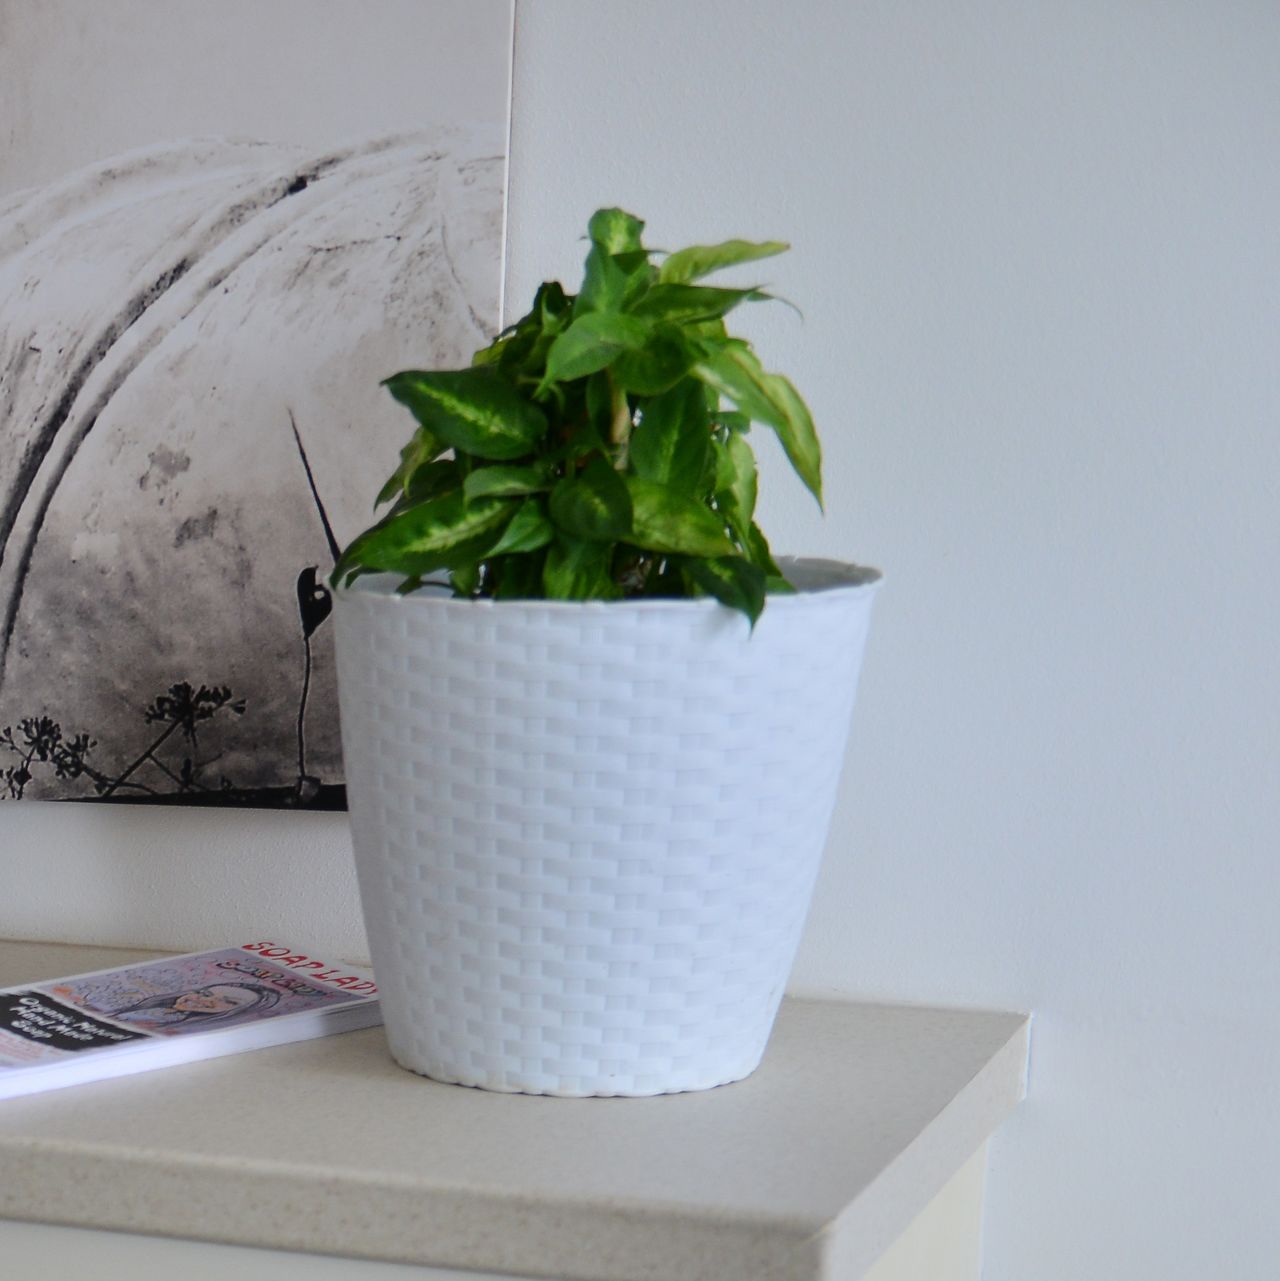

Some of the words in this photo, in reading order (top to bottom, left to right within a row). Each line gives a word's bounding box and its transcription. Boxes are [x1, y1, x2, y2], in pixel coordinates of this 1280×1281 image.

[241, 941, 324, 969] SOAP
[309, 969, 379, 995] LAD
[10, 1006, 56, 1026] Hand
[19, 998, 76, 1024] Organic
